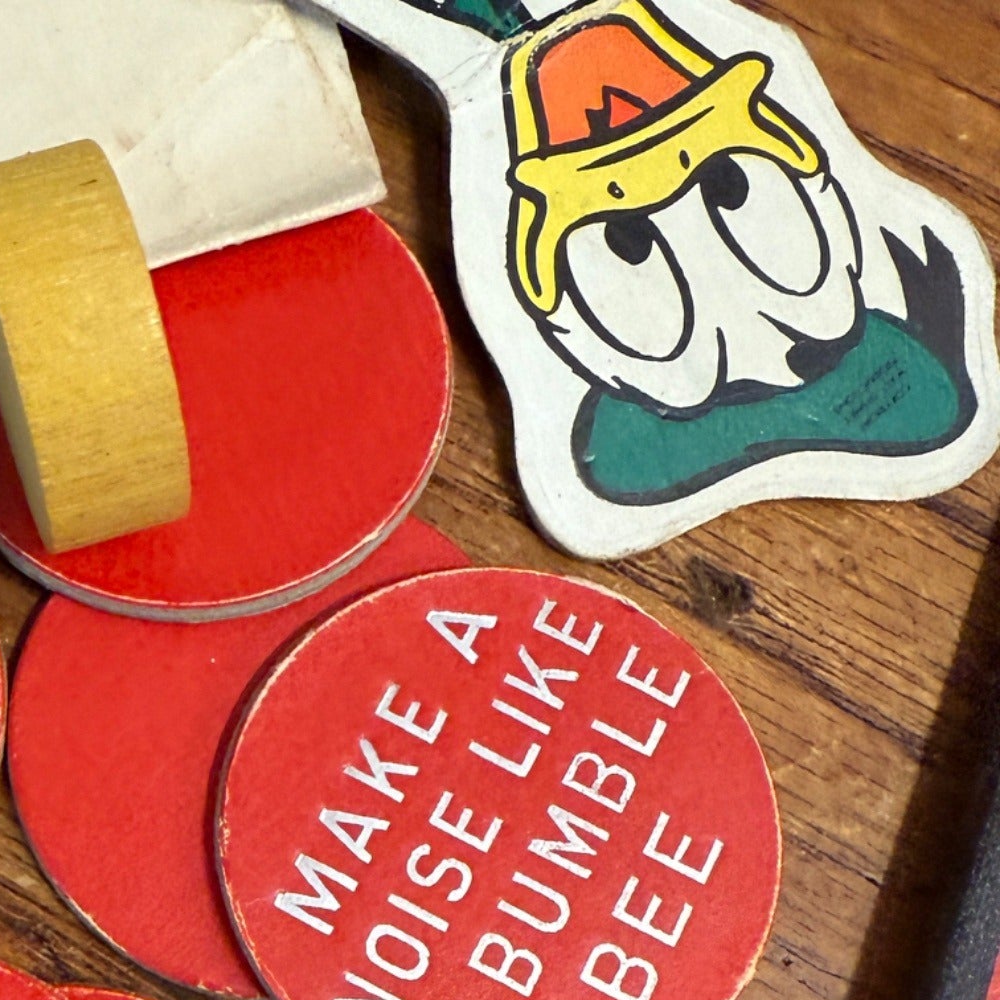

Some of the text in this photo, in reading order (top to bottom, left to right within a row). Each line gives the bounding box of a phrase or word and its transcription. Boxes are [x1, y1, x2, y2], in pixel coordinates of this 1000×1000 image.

[274, 610, 498, 935] MAKE A
[468, 598, 604, 778] LIKE
[469, 645, 692, 997] BUMBLE
